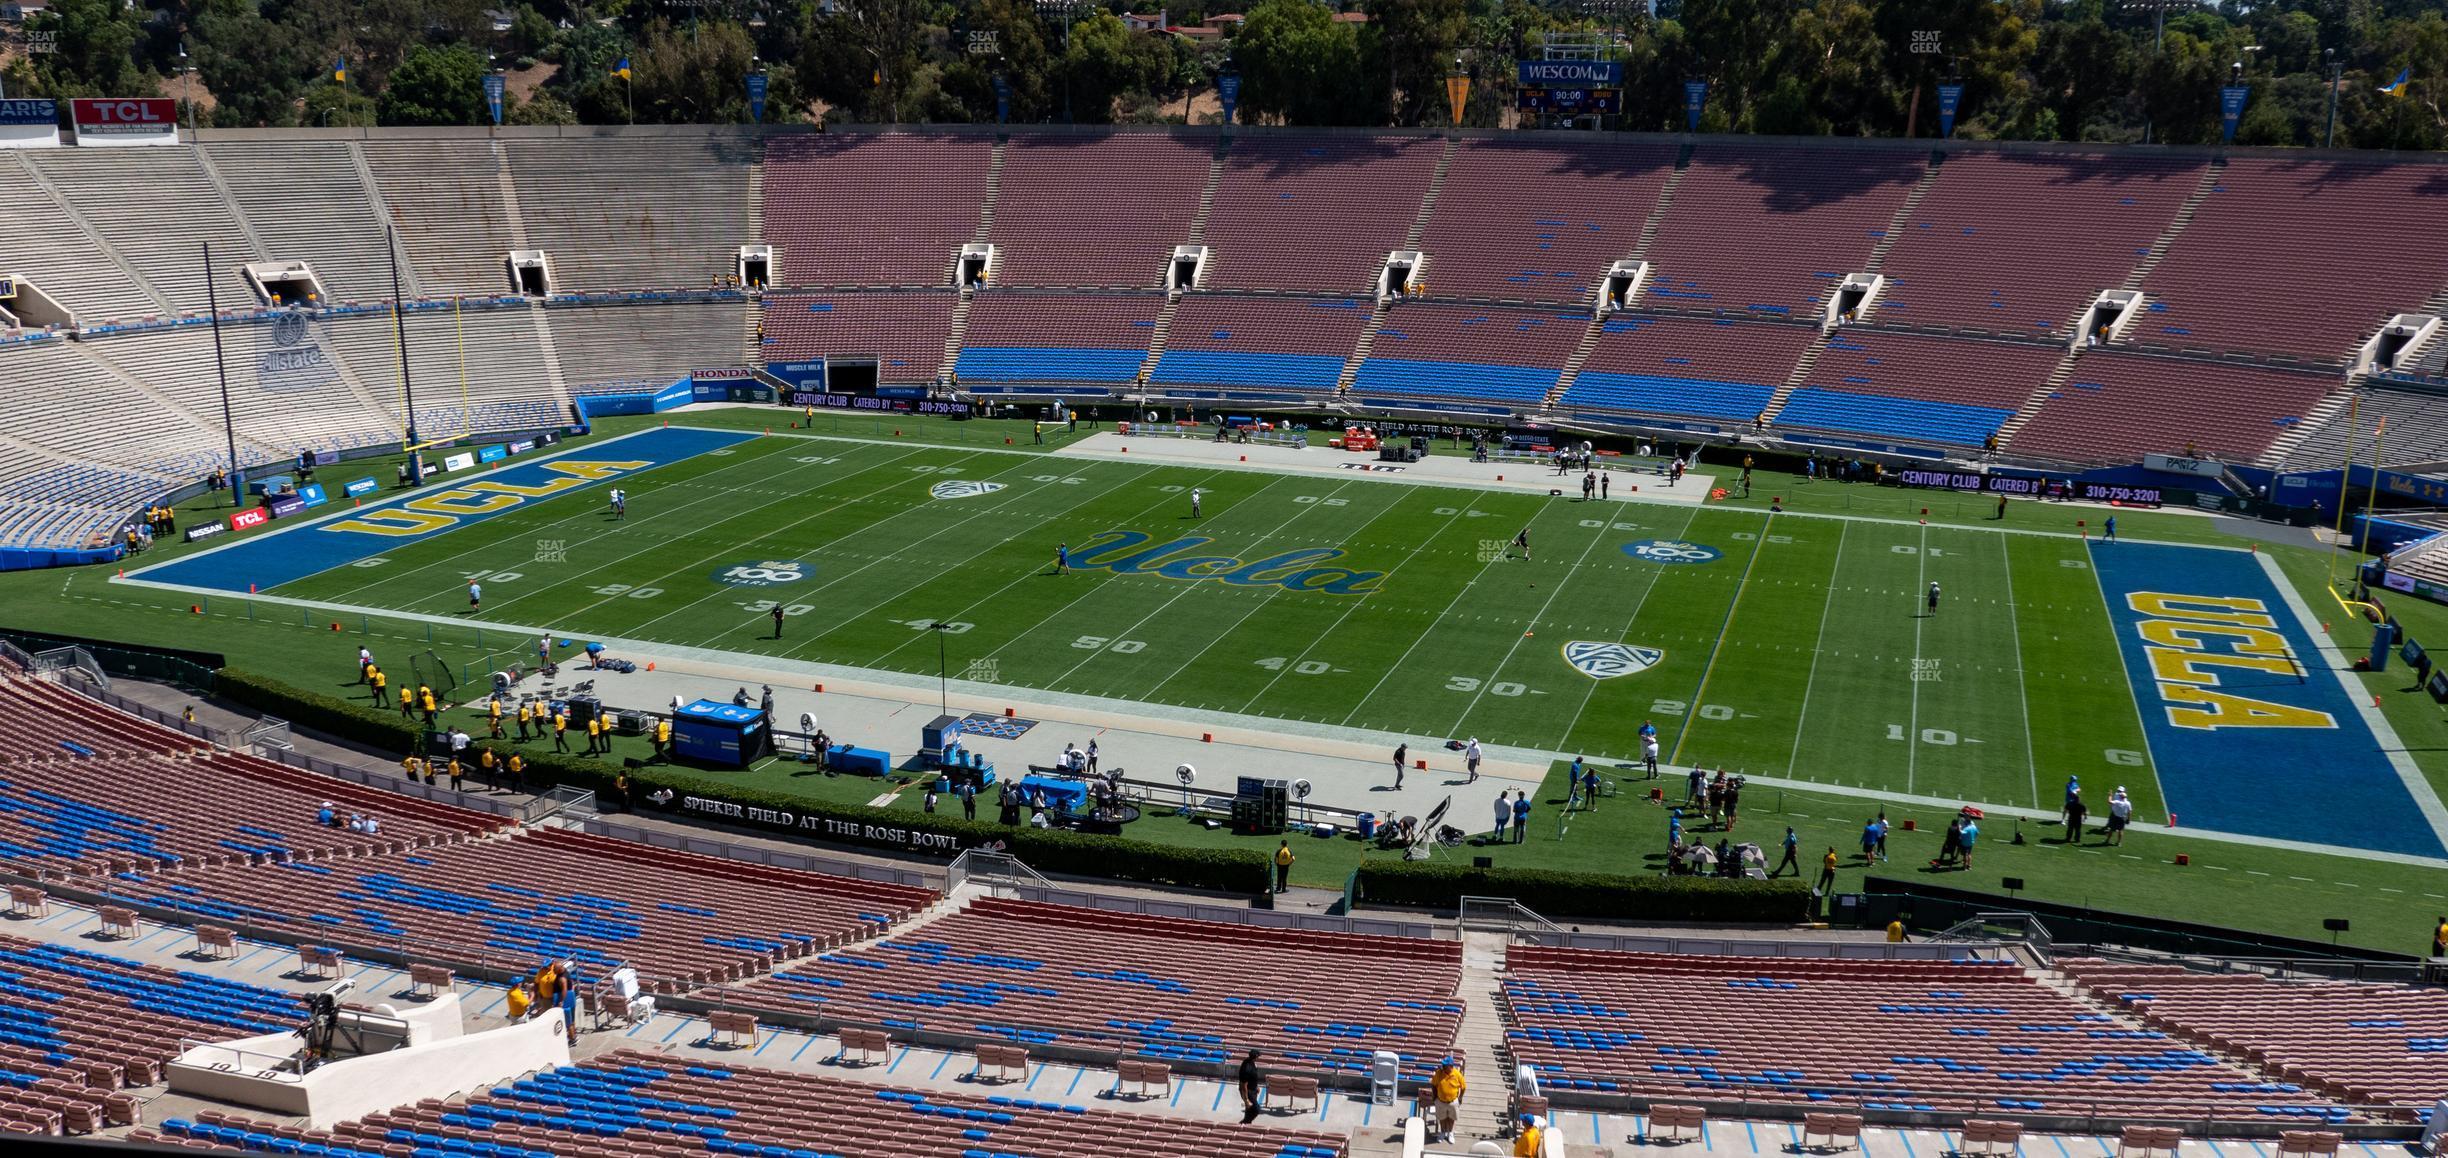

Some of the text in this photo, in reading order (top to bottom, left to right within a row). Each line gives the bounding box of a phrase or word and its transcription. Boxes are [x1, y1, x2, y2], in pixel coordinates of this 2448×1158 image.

[1529, 65, 1592, 79] WESCOM
[1556, 91, 1580, 100] 90:00
[92, 102, 160, 122] TCL
[263, 349, 320, 372] Allstate
[694, 369, 750, 378] HONDA
[794, 393, 826, 406] CENTURY
[827, 394, 847, 406] CLUB
[854, 397, 880, 409] CATERED
[882, 399, 891, 409] BY
[1344, 420, 1377, 429] SPIEKER
[1380, 422, 1405, 431] FIELD
[1419, 425, 1439, 433] THE
[1902, 470, 1951, 486] CENTURY
[1952, 473, 1980, 489] CLUB
[1990, 477, 2029, 493] CATERED
[2086, 485, 2161, 502] 310-750-3201
[316, 460, 656, 537] UCLA
[236, 512, 263, 527] TCL
[189, 523, 225, 538] NISSAN
[1635, 545, 1714, 559] 100
[1054, 531, 1390, 595] Ucla
[722, 577, 769, 586] YEARS
[723, 566, 803, 581] 100
[593, 583, 665, 599] 20
[744, 600, 816, 616] 30
[904, 618, 975, 634] 40
[1070, 635, 1147, 654] 50
[1253, 656, 1332, 676] 40
[1585, 660, 1627, 674] 12
[2125, 590, 2340, 731] UCLA
[1445, 676, 1528, 698] 30
[1649, 699, 1736, 722] 20
[1886, 724, 1959, 746] 10
[682, 795, 962, 851] SPIEKER FIELD AT THE ROSE BOWL
[208, 1061, 278, 1081] 19 19
